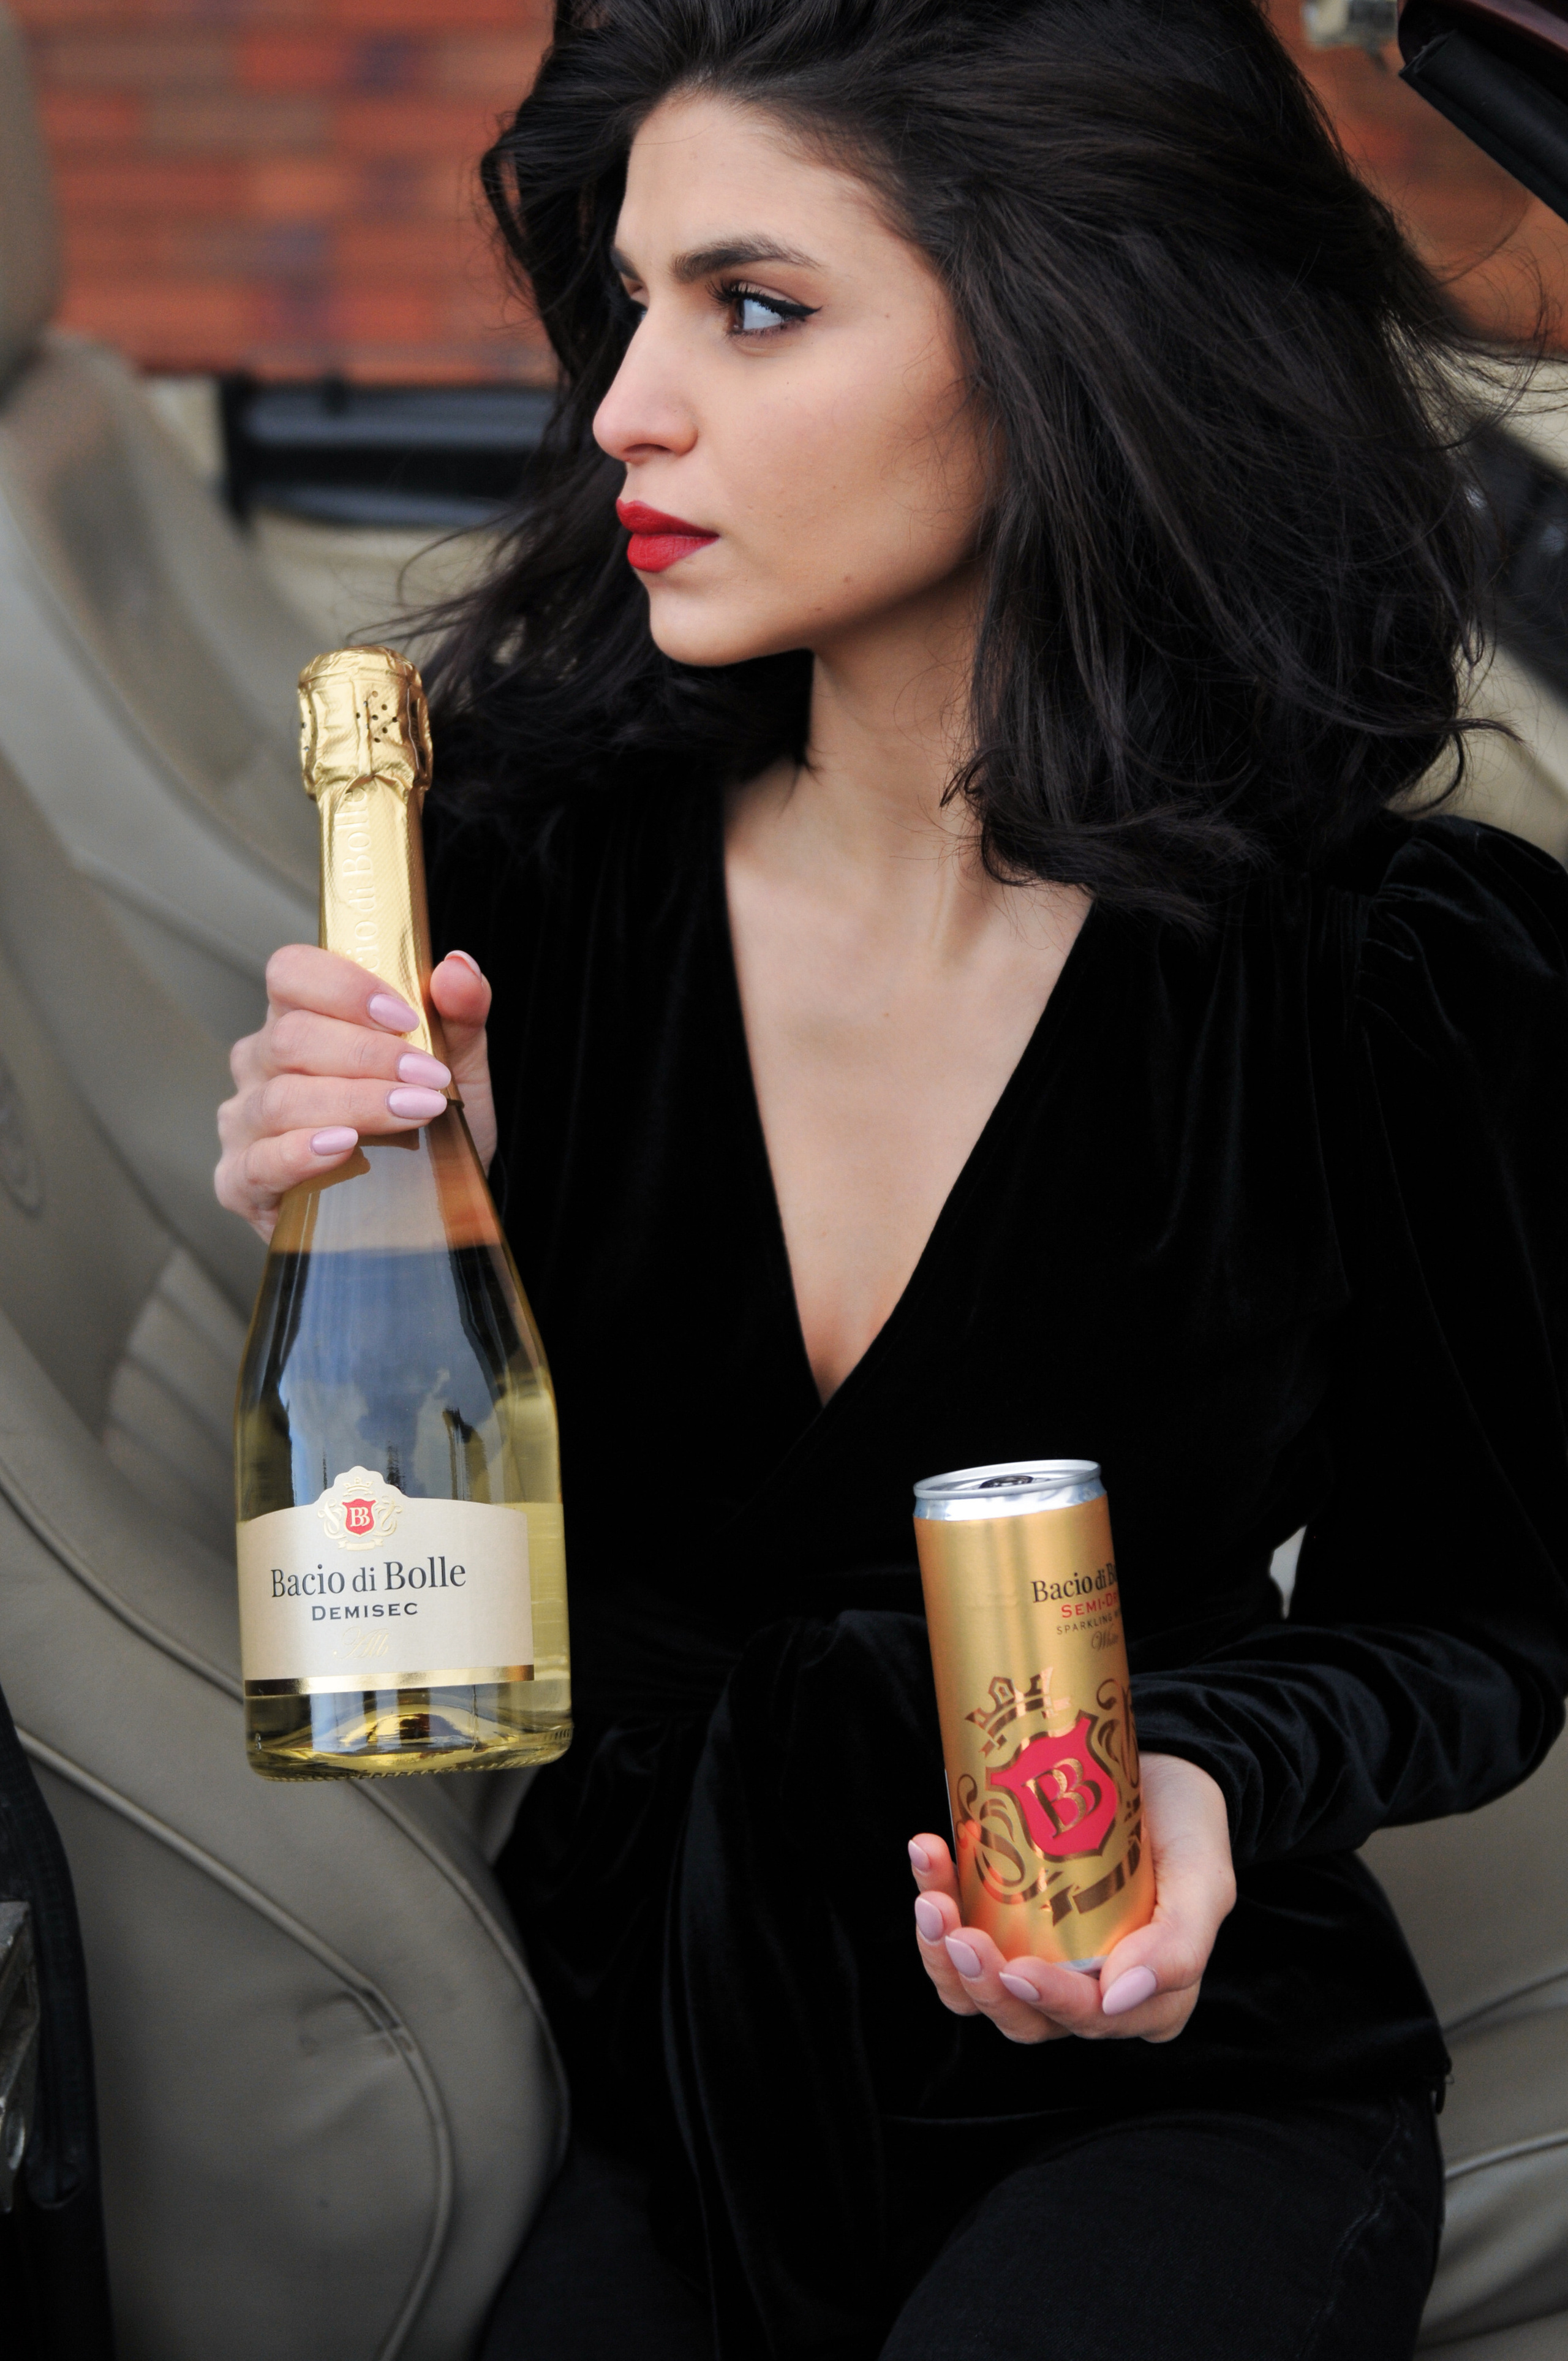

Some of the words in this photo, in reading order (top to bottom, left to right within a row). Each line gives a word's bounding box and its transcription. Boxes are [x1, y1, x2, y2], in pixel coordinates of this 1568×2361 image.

[335, 787, 373, 877] Bolle
[348, 885, 376, 912] di
[345, 920, 380, 974] cio
[271, 1564, 345, 1598] Bacio
[352, 1566, 377, 1592] di
[383, 1556, 466, 1591] Bolle
[1031, 1572, 1093, 1604] Bacio
[1095, 1568, 1107, 1590] di
[312, 1602, 418, 1622] DEMISEC
[1057, 1613, 1113, 1635] SPARKLING
